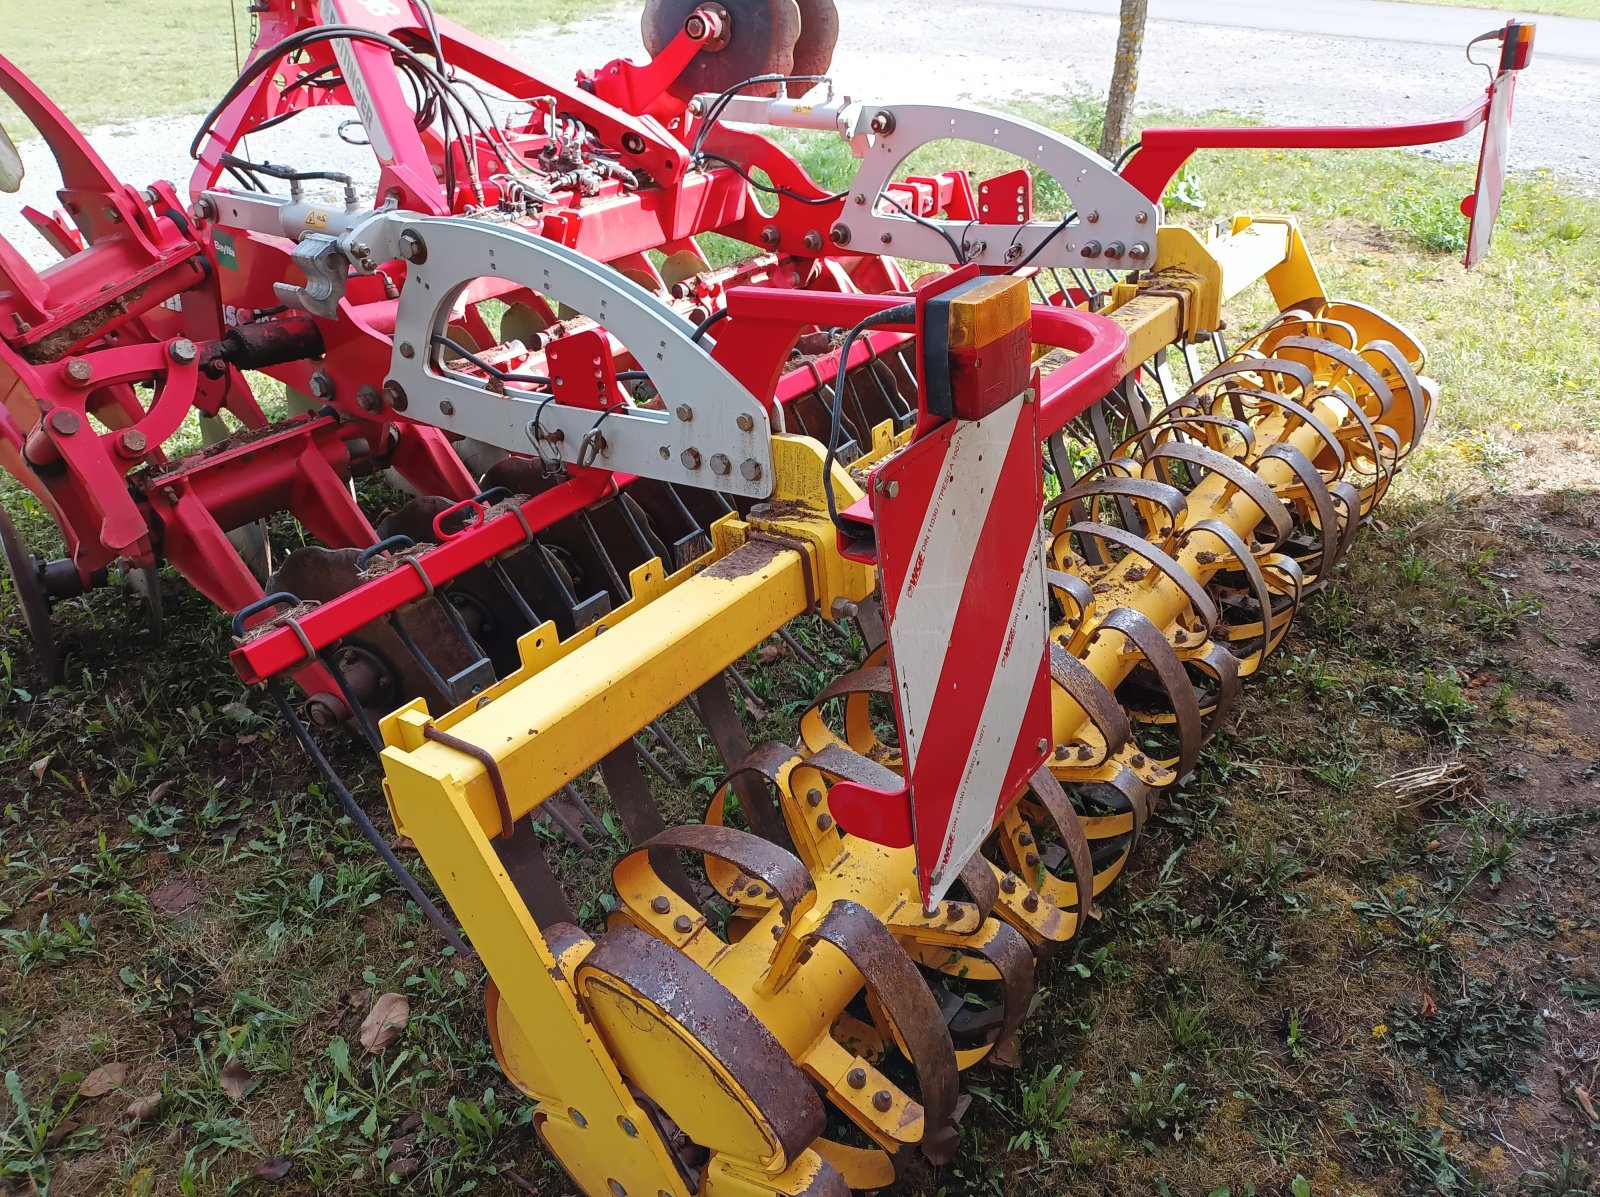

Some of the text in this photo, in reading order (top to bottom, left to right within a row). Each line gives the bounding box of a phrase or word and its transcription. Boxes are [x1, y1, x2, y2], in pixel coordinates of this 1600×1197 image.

[921, 535, 930, 553] DIN
[927, 508, 940, 533] 11030
[1012, 612, 1020, 629] DIN
[951, 816, 959, 833] DIN
